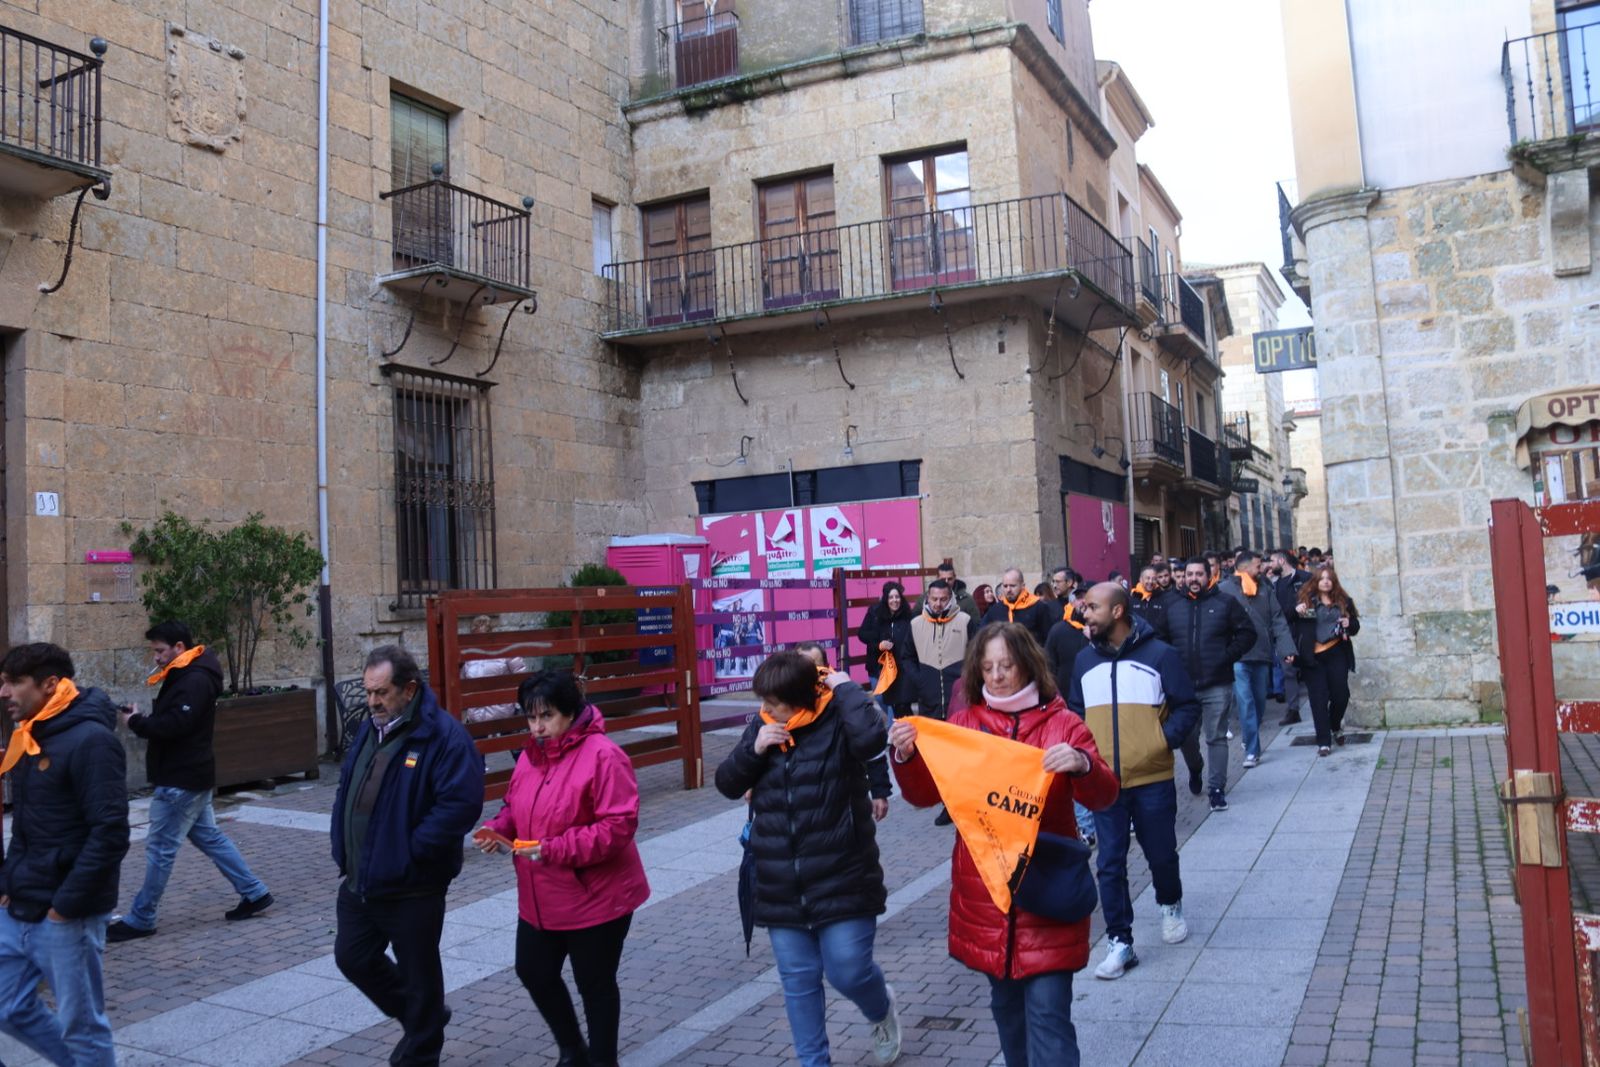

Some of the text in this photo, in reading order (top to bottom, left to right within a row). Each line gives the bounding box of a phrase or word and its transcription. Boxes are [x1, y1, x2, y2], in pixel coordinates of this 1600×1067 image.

[1548, 394, 1600, 418] OPT
[703, 579, 712, 588] NO
[719, 579, 728, 588] NO
[1554, 610, 1600, 626] ROHI
